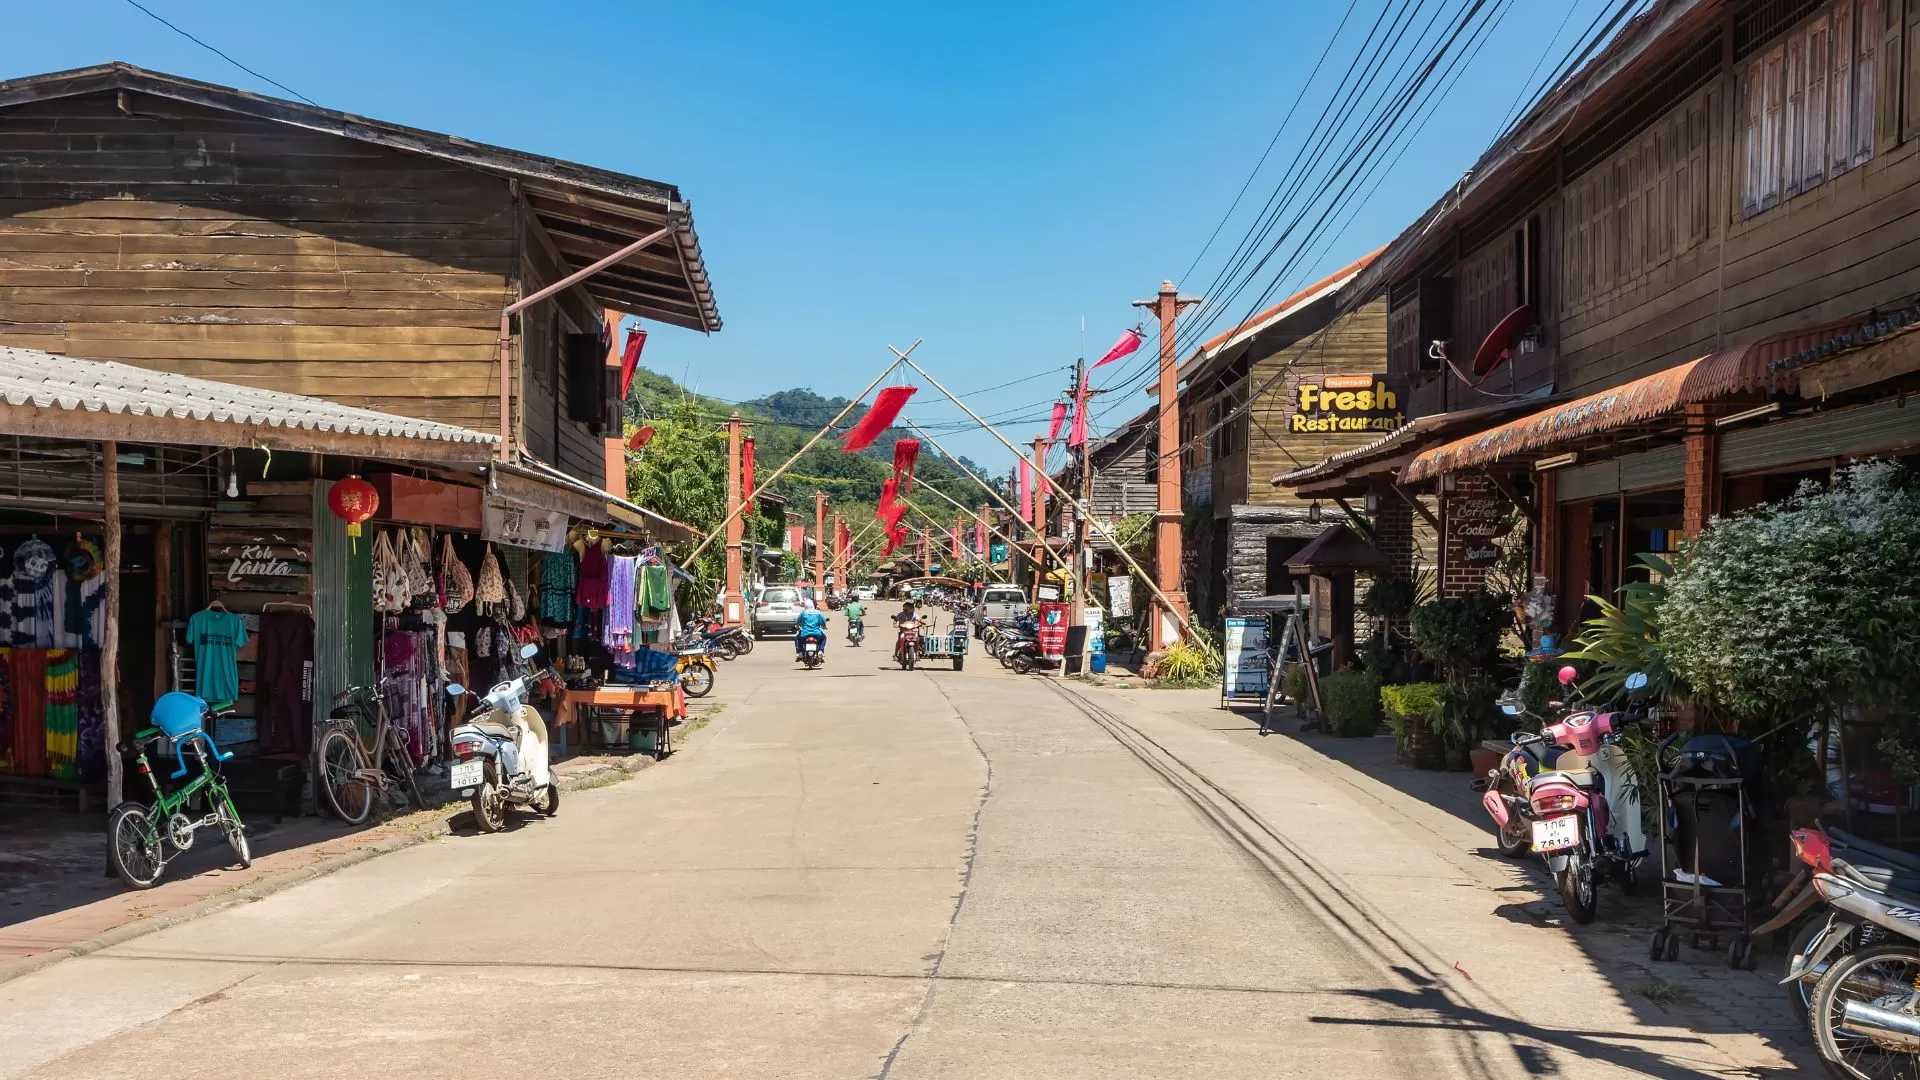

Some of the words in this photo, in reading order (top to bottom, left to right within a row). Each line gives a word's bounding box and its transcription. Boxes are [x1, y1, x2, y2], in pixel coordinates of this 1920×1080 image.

[1298, 381, 1397, 411] Fresh
[1292, 412, 1406, 432] Restaurant
[1457, 505, 1497, 518] Coffee
[1457, 522, 1497, 535] Cocktail
[241, 545, 274, 559] Koh
[1464, 545, 1497, 560] Seafood
[227, 557, 292, 583] Lanta
[1541, 837, 1569, 848] 7818
